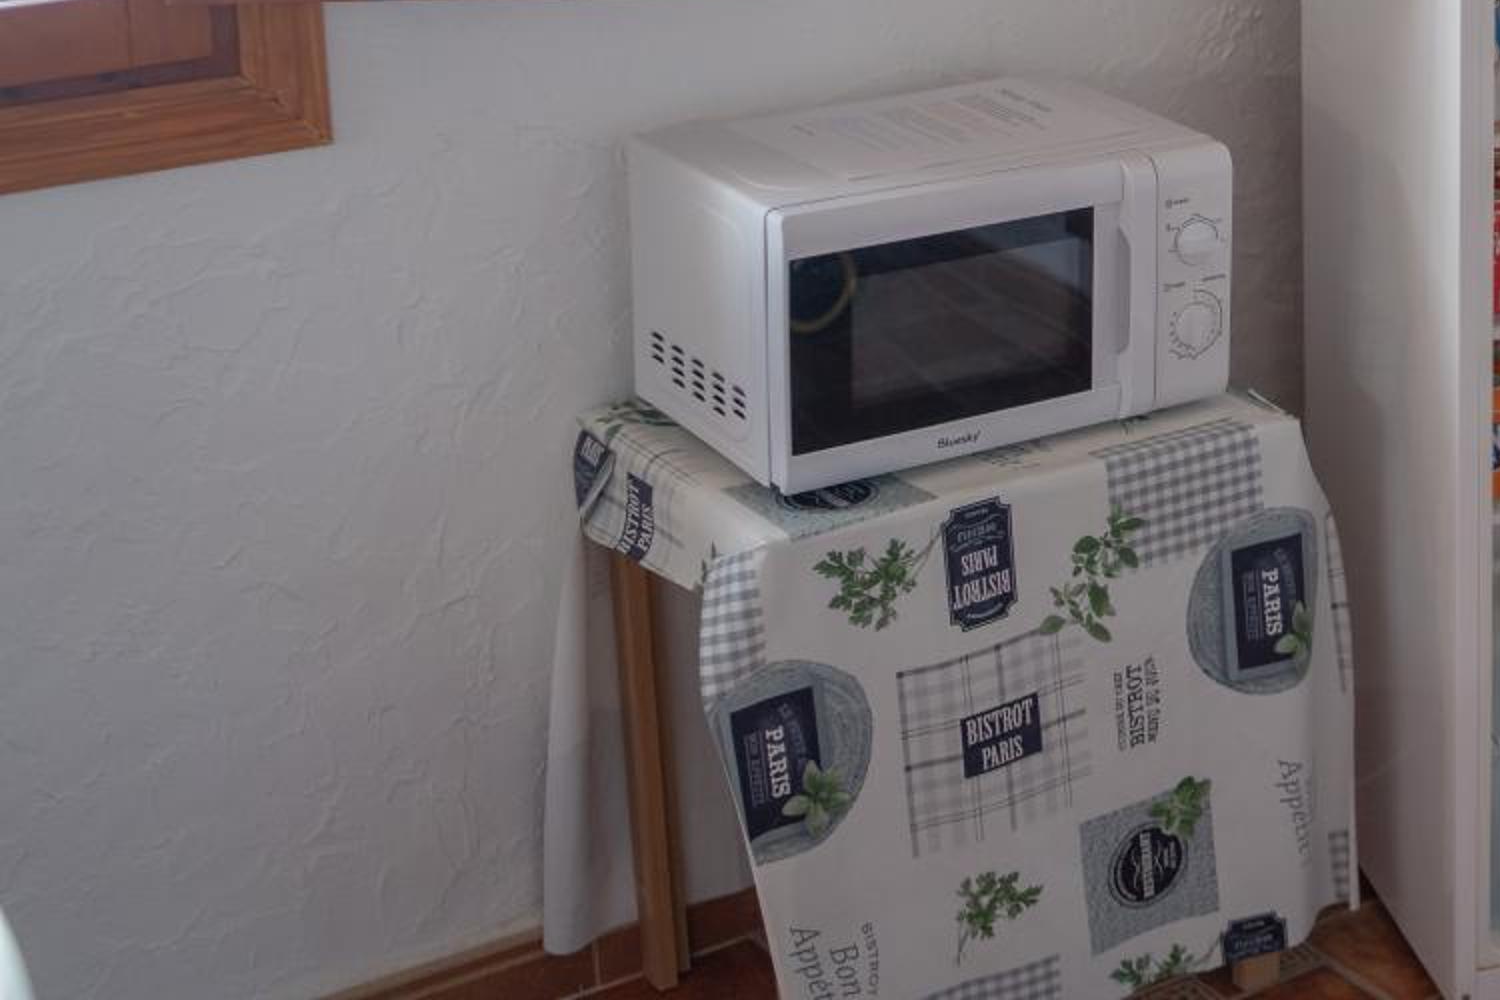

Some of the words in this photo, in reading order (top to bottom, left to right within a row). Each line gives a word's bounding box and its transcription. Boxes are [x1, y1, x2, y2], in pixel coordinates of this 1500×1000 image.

[961, 544, 999, 576] PARIS
[952, 567, 1012, 611] BISTROT
[1261, 567, 1284, 637] PARIS
[965, 697, 1034, 747] BISTROT
[1125, 663, 1149, 748] BISTROT
[764, 725, 791, 799] PARIS
[980, 735, 1024, 772] PARIS
[829, 943, 862, 998] Bon
